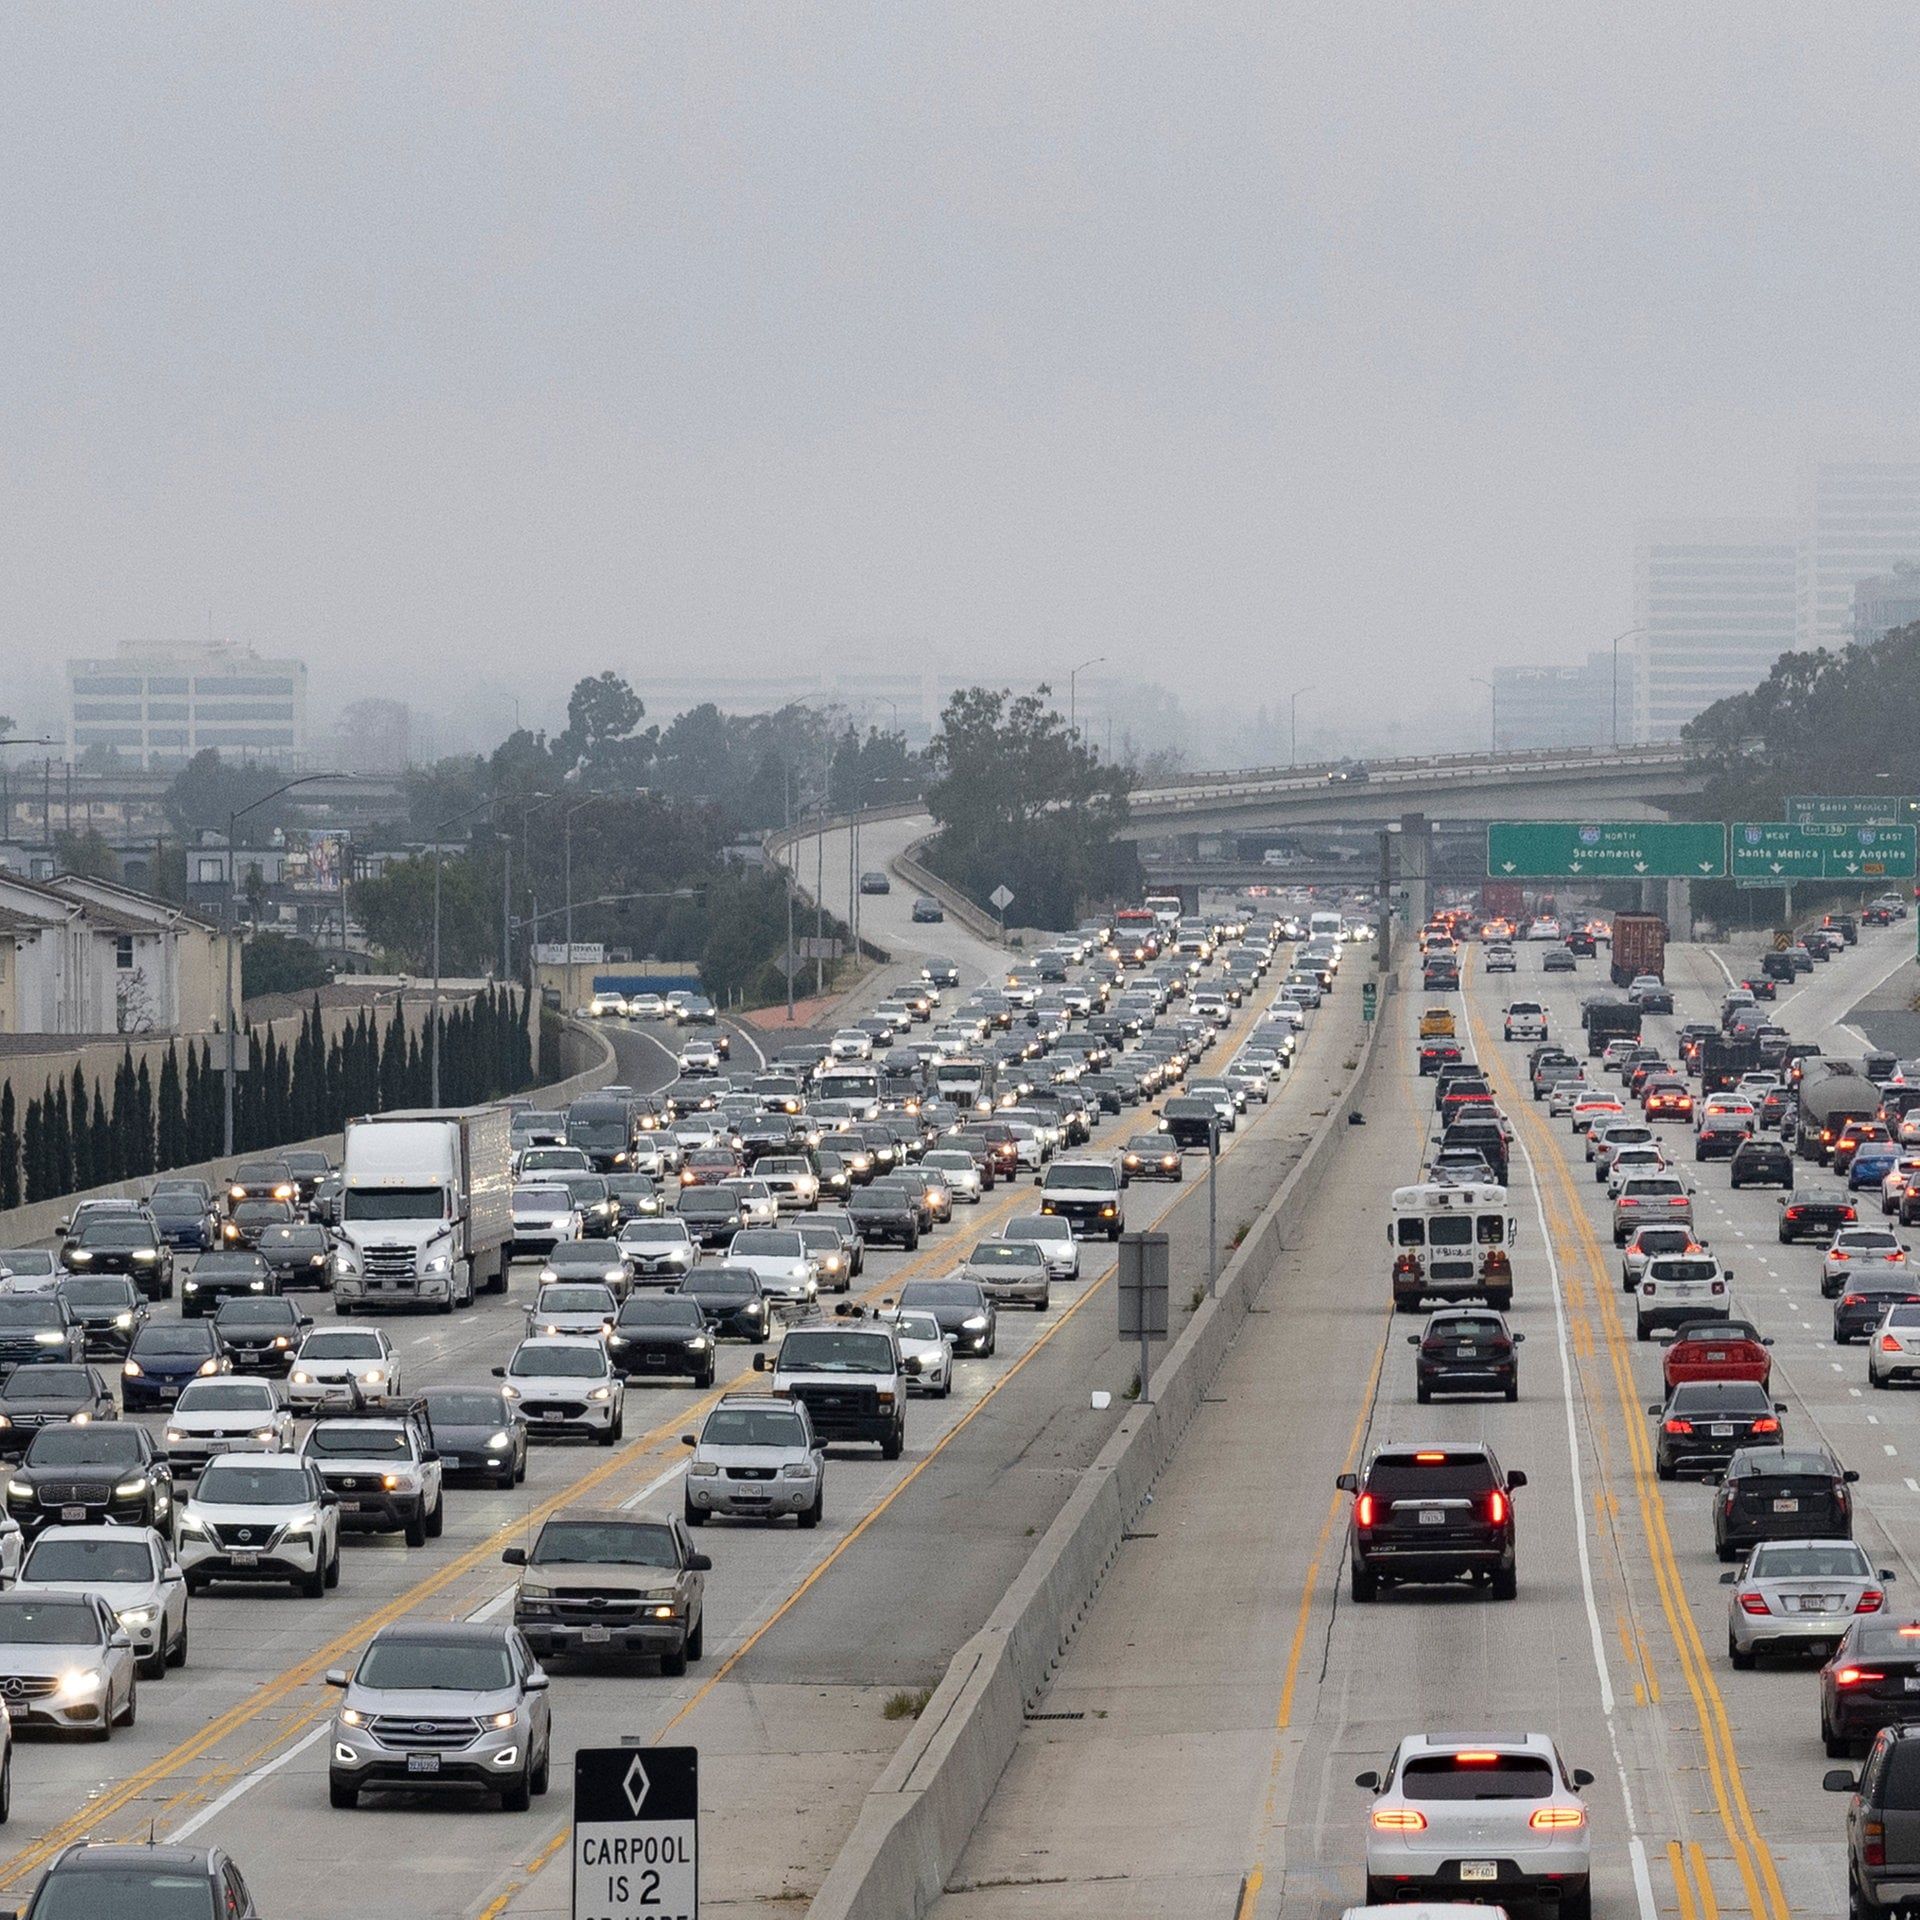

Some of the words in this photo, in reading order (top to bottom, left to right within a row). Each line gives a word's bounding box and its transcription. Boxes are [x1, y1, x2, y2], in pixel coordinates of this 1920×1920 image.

[1604, 832, 1636, 841] NORTH
[1765, 831, 1790, 840] WEST
[1879, 832, 1903, 841] EAST
[1572, 847, 1643, 858] Sacramento
[1738, 848, 1772, 858] Santa
[1777, 848, 1819, 859] Monica
[1833, 849, 1854, 859] Los
[1859, 849, 1906, 860] Angeles
[583, 1836, 690, 1865] CARPOOL
[608, 1876, 629, 1902] IS
[640, 1869, 661, 1905] 2
